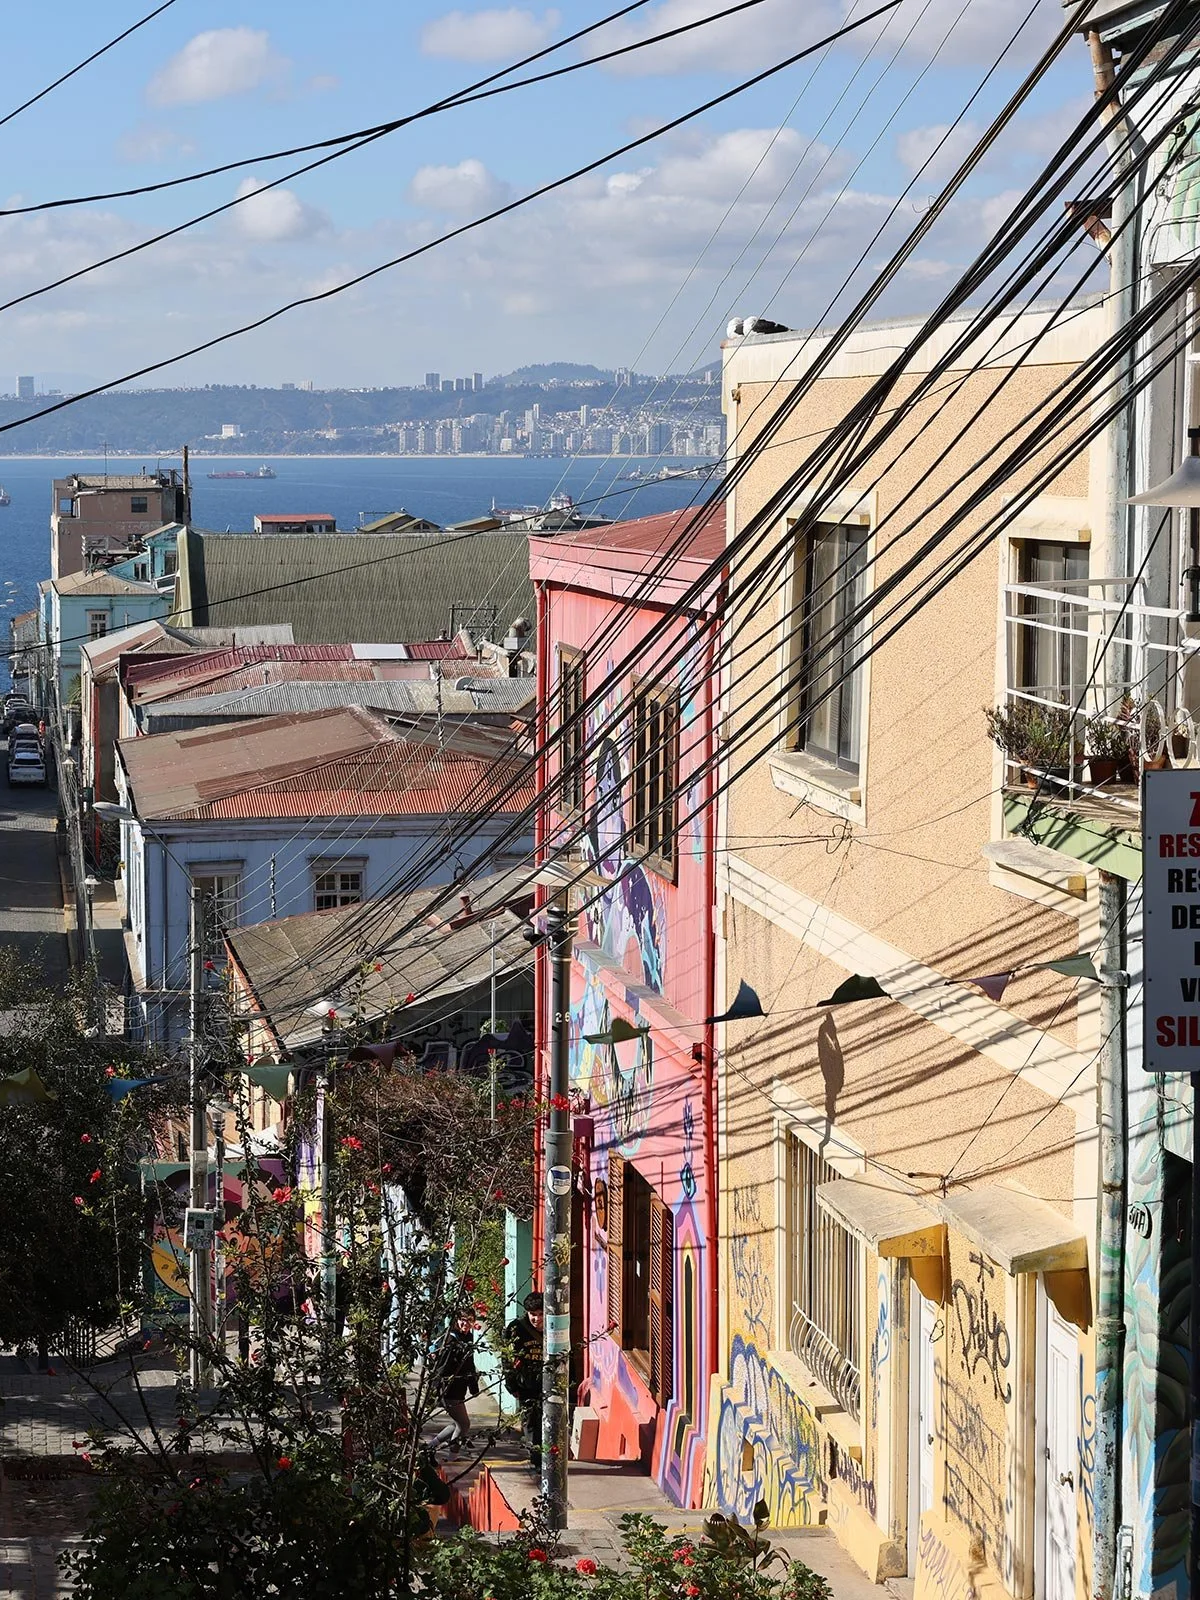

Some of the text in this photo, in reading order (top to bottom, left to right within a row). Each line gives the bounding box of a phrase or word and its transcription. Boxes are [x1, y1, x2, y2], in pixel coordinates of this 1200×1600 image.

[1168, 868, 1200, 893] RE
[1172, 905, 1200, 929] DE
[555, 1011, 571, 1023] 26
[1156, 1016, 1200, 1047] SIL
